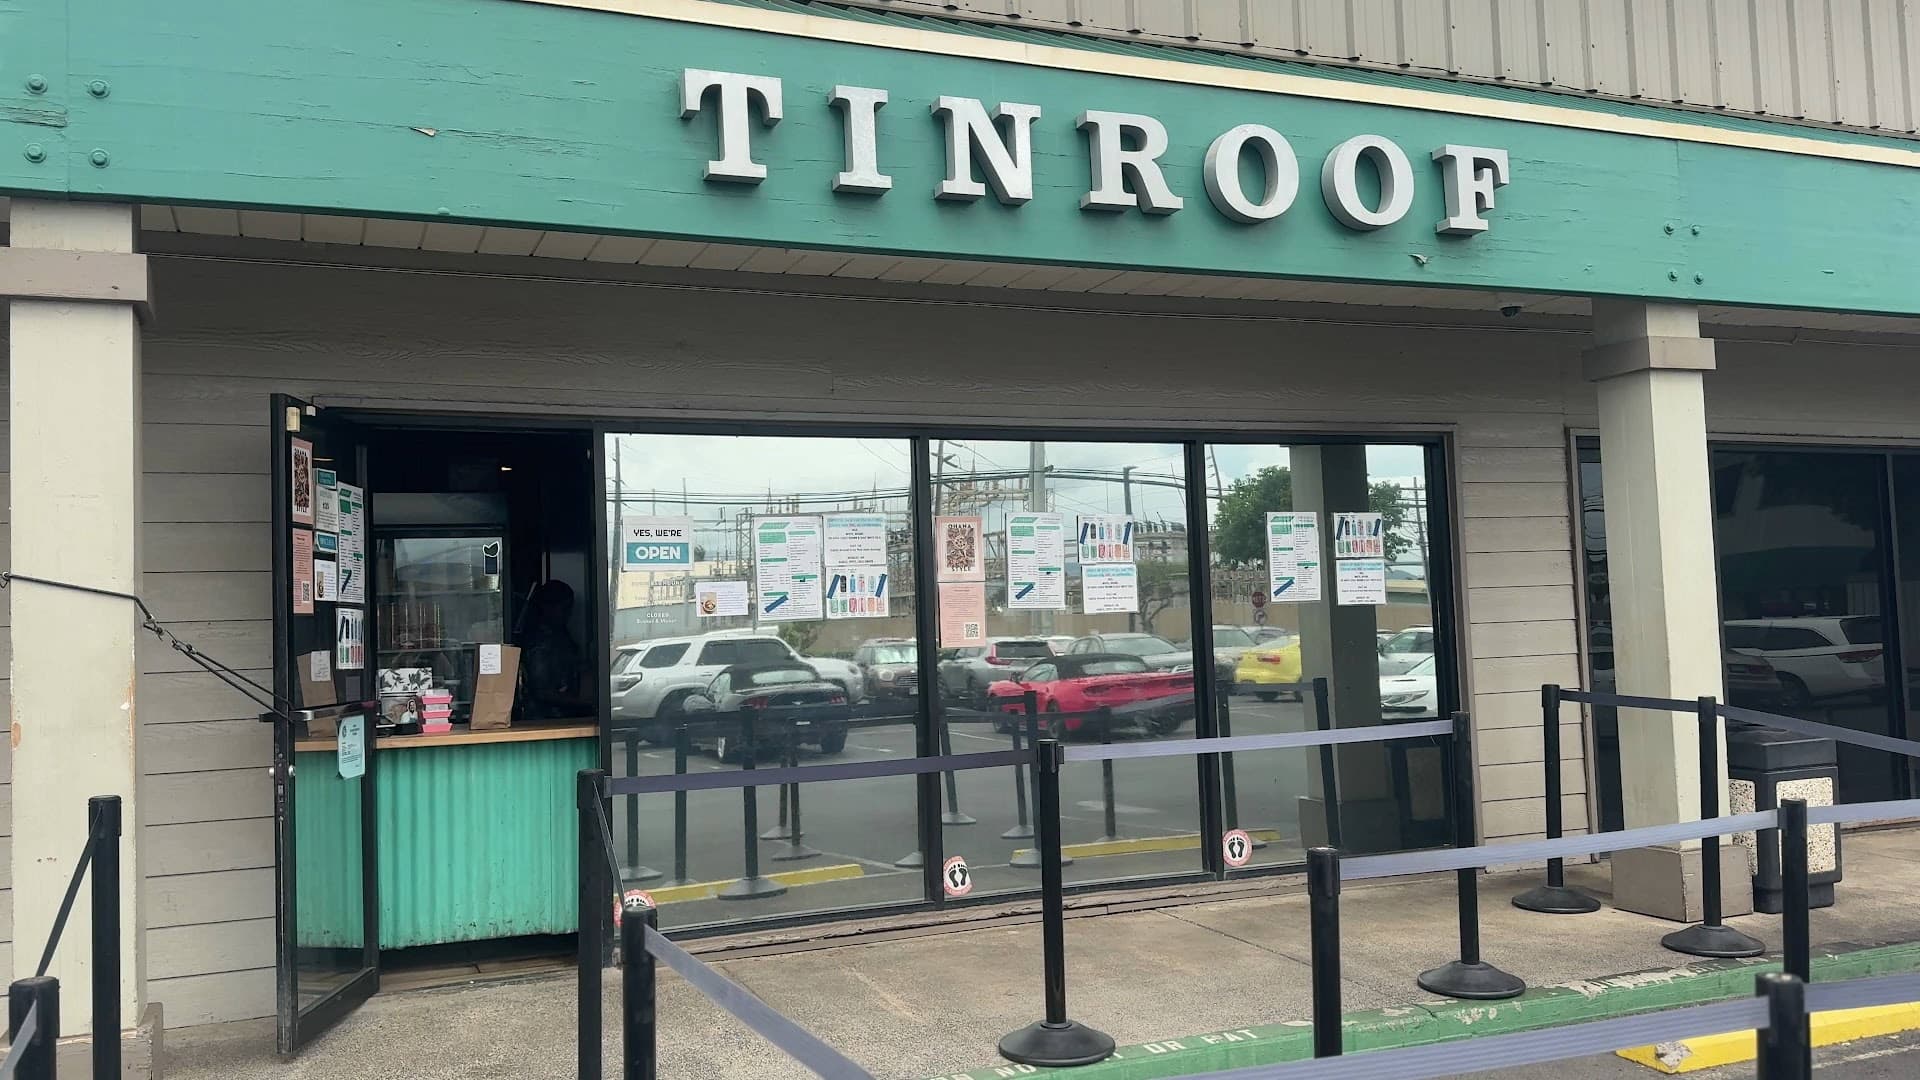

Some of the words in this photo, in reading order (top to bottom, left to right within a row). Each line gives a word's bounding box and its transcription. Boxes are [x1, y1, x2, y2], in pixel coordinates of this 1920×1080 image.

[680, 67, 1510, 236] TINROOF
[633, 528, 654, 538] YES,
[655, 528, 683, 537] WE'RE
[635, 545, 682, 561] OPEN
